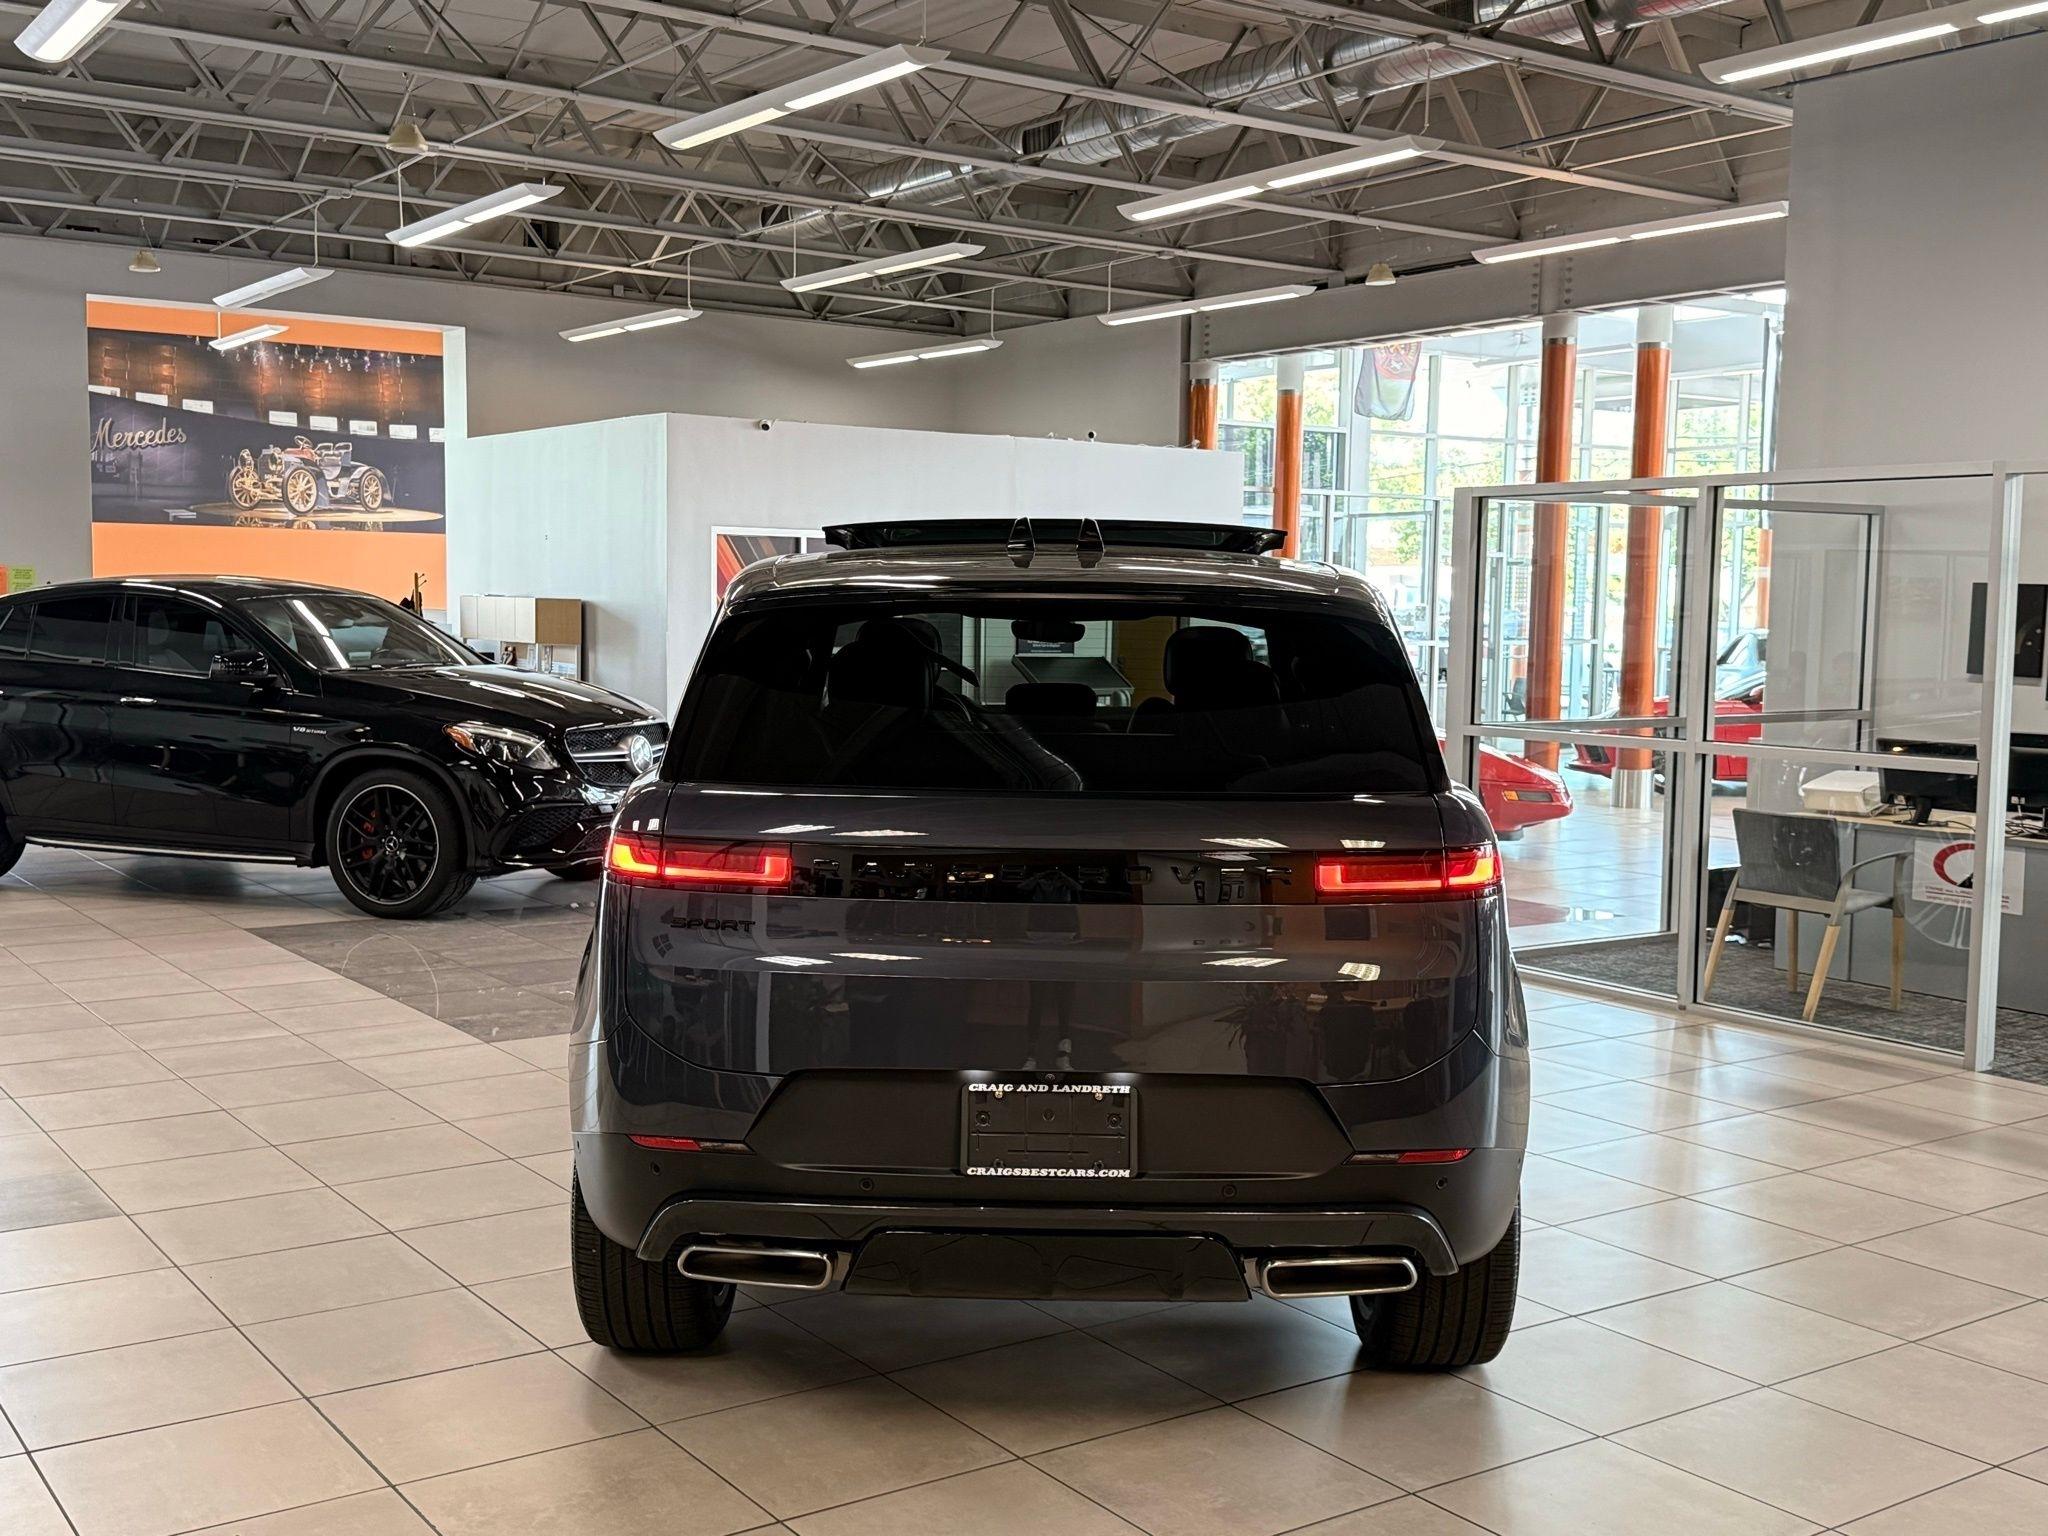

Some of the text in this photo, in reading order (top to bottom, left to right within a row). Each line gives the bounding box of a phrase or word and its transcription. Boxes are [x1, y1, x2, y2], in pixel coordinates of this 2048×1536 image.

[90, 416, 187, 452] Mercedes
[670, 917, 756, 933] SPORT
[968, 1083, 1131, 1094] CRAIG AND LANDRETH
[966, 1167, 1131, 1178] CRAIGSBESTCARS.COM
